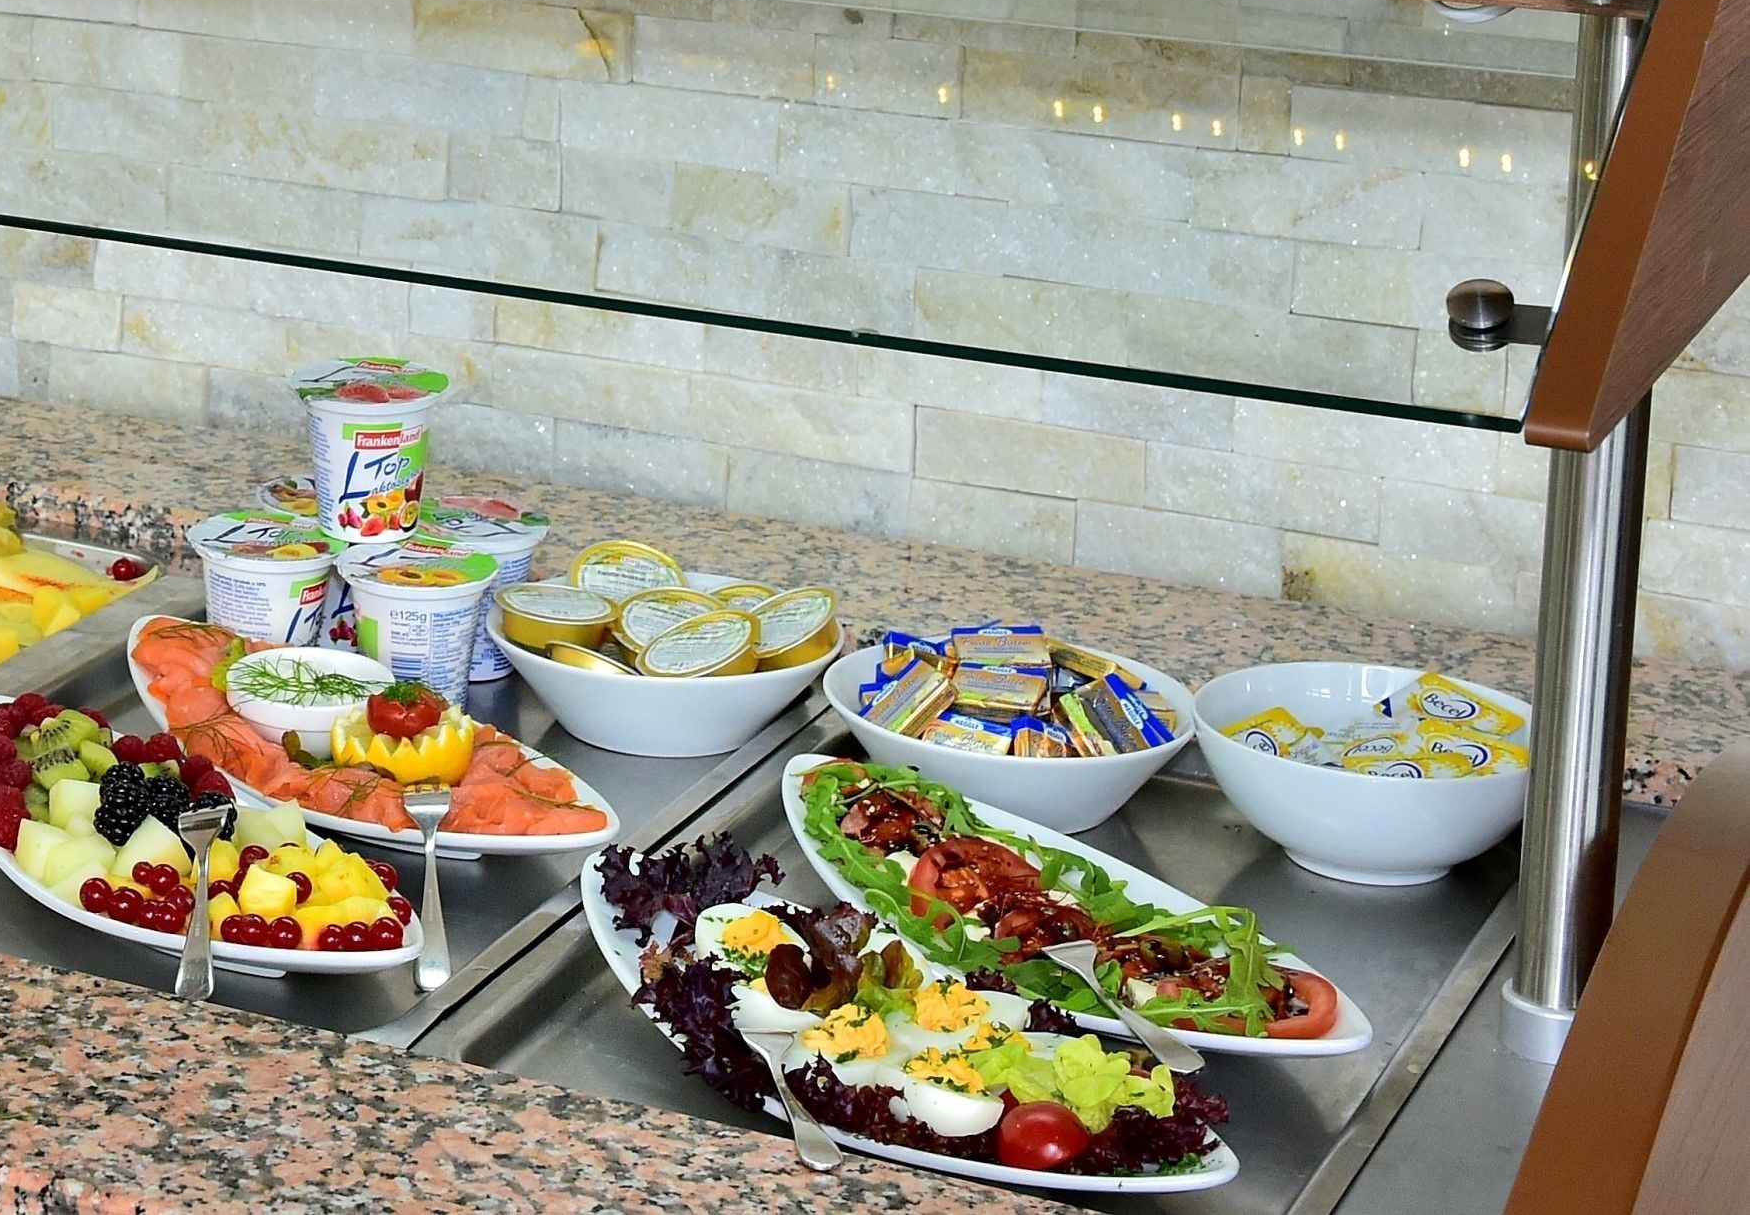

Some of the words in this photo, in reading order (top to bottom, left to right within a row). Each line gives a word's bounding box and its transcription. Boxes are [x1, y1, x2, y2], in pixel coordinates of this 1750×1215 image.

[356, 428, 420, 446] Frankenland
[364, 452, 410, 480] Top
[1424, 693, 1467, 717] Becel
[954, 719, 980, 730] MEGGLE
[1431, 742, 1479, 765] Bel
